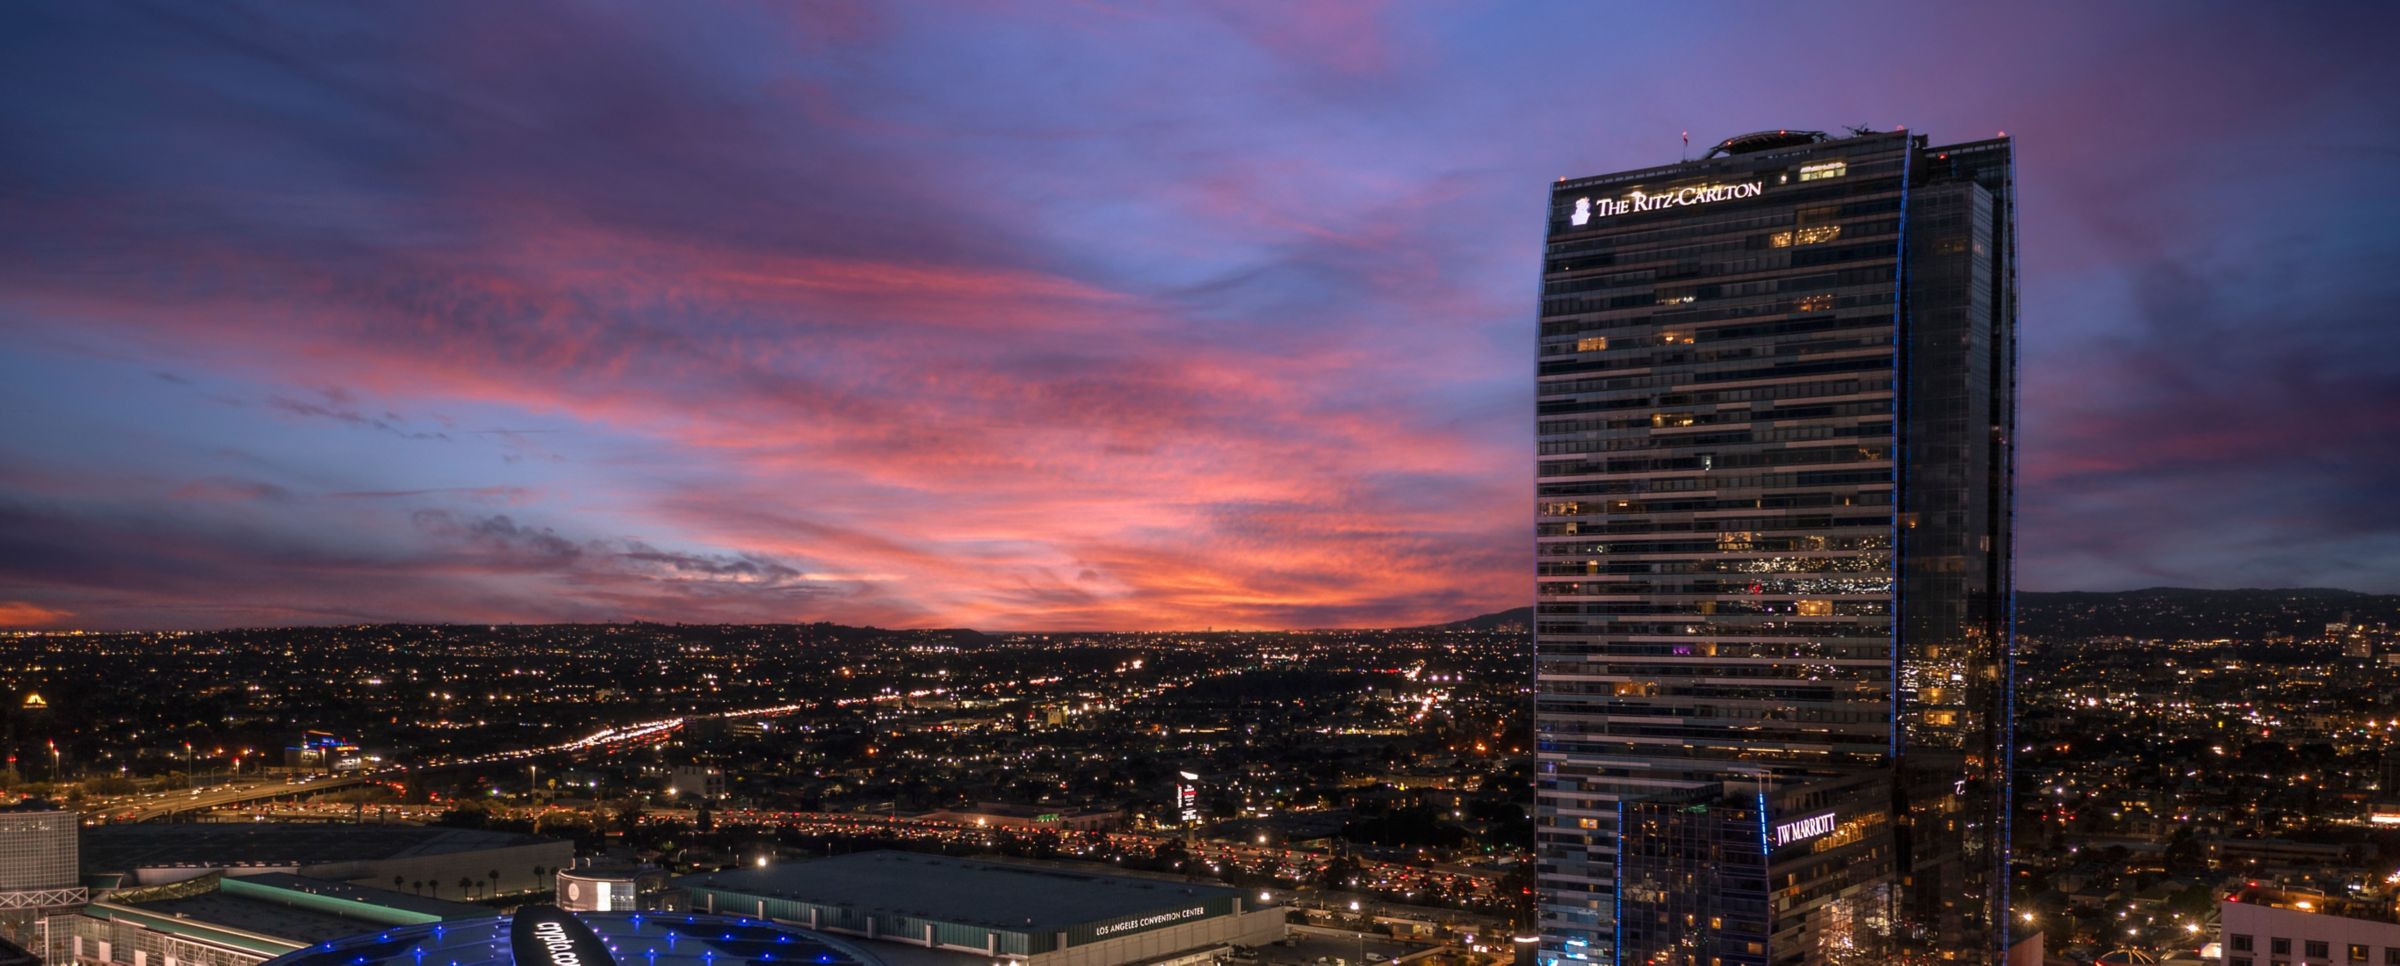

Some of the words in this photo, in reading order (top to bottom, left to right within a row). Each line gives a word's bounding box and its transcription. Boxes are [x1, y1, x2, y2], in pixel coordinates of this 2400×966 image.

[1596, 198, 1630, 216] THE
[1633, 181, 1762, 213] RITZ-CARLTON
[1776, 824, 1791, 846] JW
[1791, 812, 1836, 841] MARRIOTT
[1096, 926, 1111, 936] LOS
[1110, 919, 1139, 933] ANGELES
[1140, 912, 1181, 927] CONVENTION
[1182, 907, 1204, 918] CENTER
[534, 921, 581, 966] crypto.co
